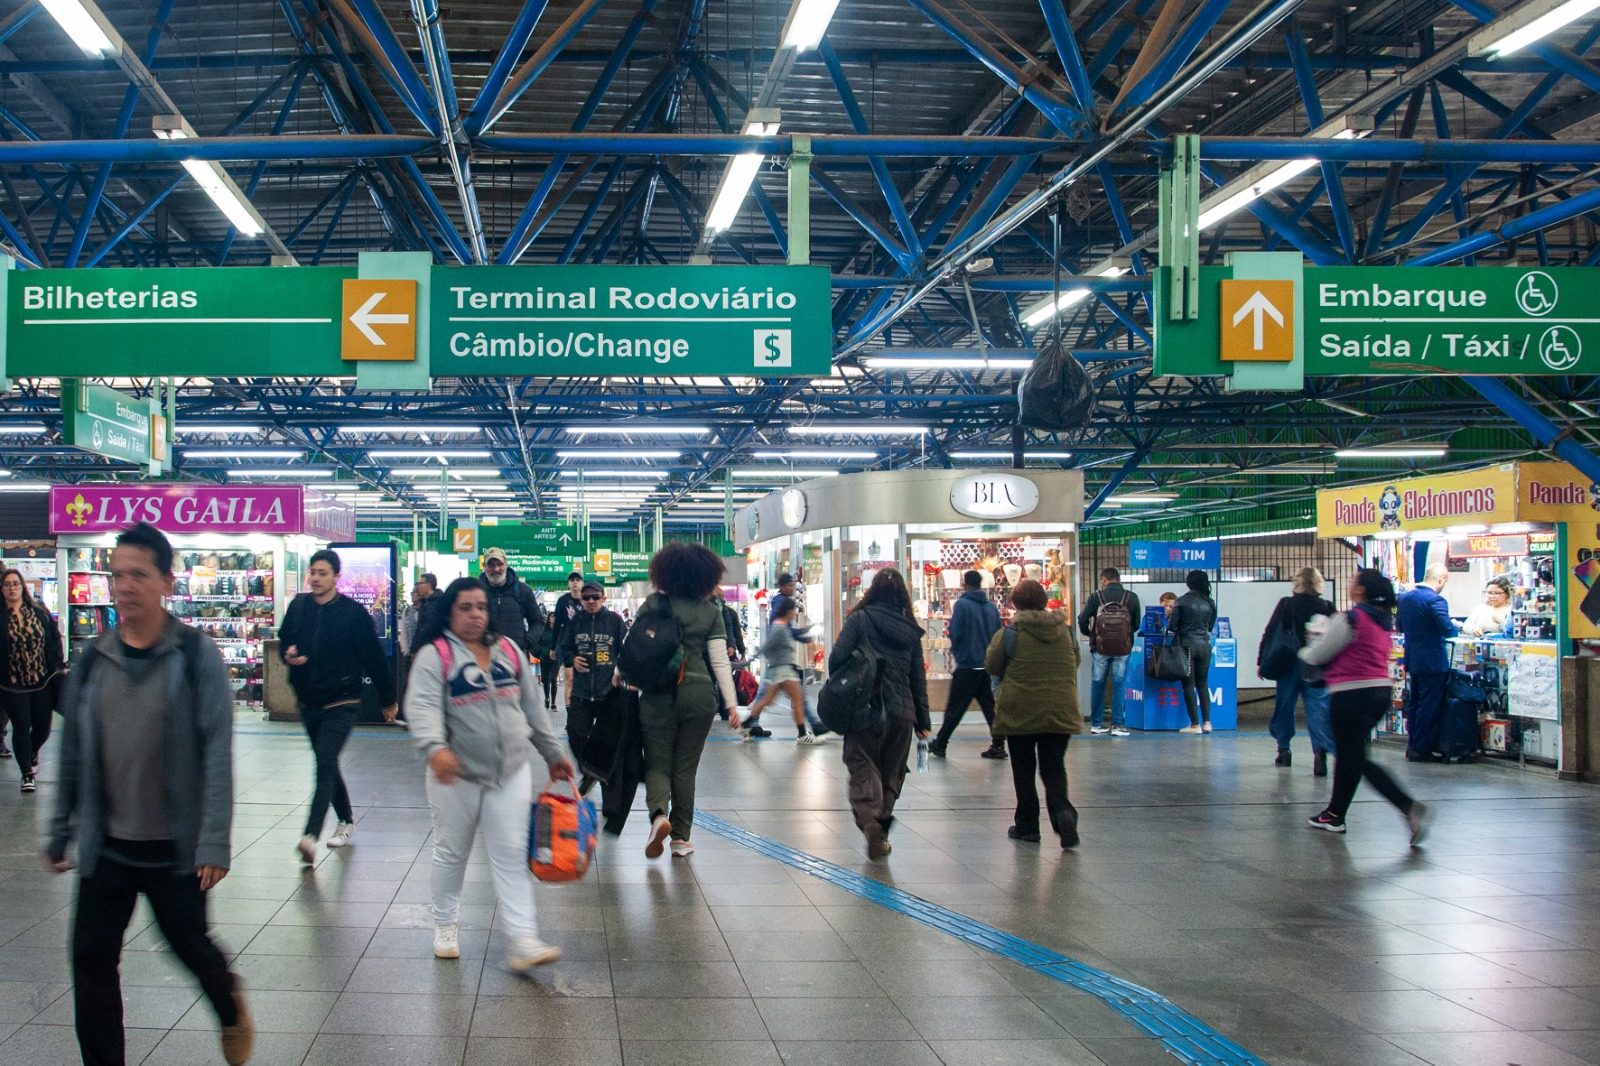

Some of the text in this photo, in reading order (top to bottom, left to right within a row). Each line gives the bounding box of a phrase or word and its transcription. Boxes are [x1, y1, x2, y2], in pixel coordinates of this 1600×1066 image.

[23, 284, 198, 310] Bilheterias
[449, 286, 797, 310] Terminal Rodoviário
[1319, 283, 1487, 311] Embarque
[449, 332, 690, 364] Câmbio/Change
[1320, 333, 1411, 358] Saída
[1421, 333, 1432, 360] /
[116, 402, 148, 427] Embarque
[108, 429, 127, 448] Saída
[131, 437, 145, 454] Táxi
[974, 481, 1021, 508] BIA
[1529, 480, 1586, 505] Panda
[95, 496, 286, 524] LYS GAILA
[1334, 487, 1495, 526] Panda Eletrônicos
[1182, 549, 1205, 561] TIM
[596, 651, 610, 662] 86
[1132, 689, 1143, 701] TIM
